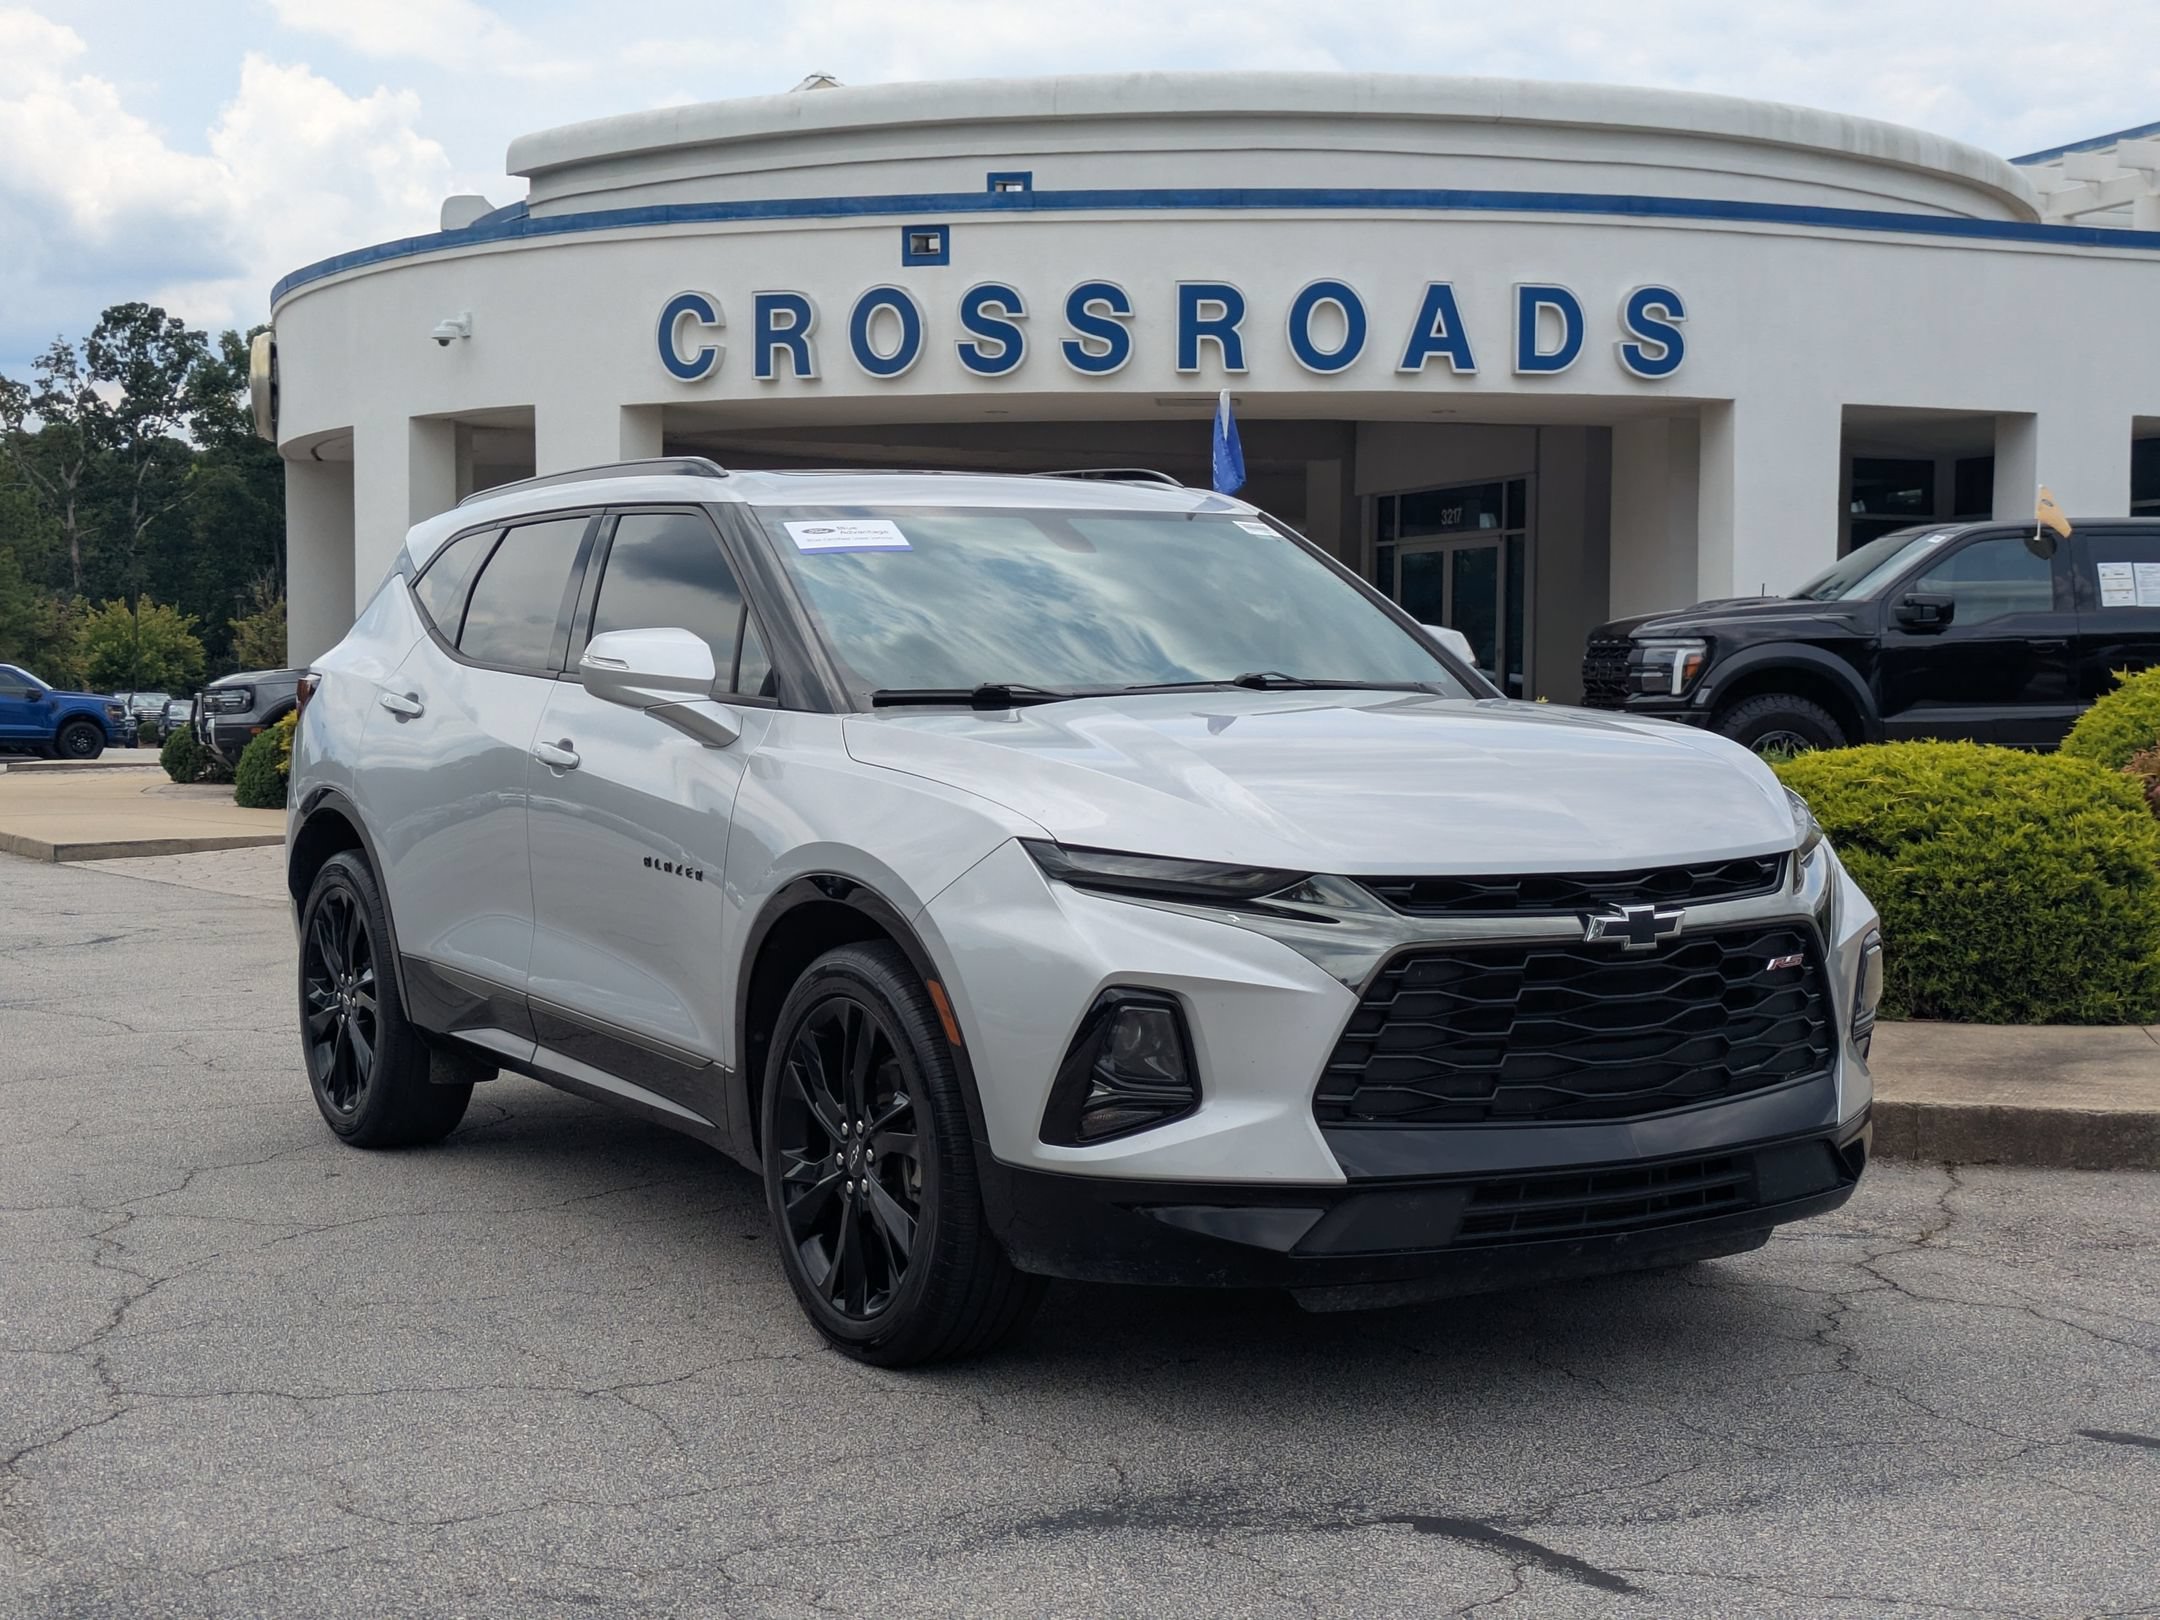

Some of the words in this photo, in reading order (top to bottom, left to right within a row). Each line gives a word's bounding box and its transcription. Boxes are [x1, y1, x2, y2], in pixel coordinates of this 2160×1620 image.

[656, 280, 1687, 382] CROSSROADS
[1441, 507, 1463, 525] 3217
[643, 856, 704, 882] BLAZER
[1766, 953, 1804, 971] RS
